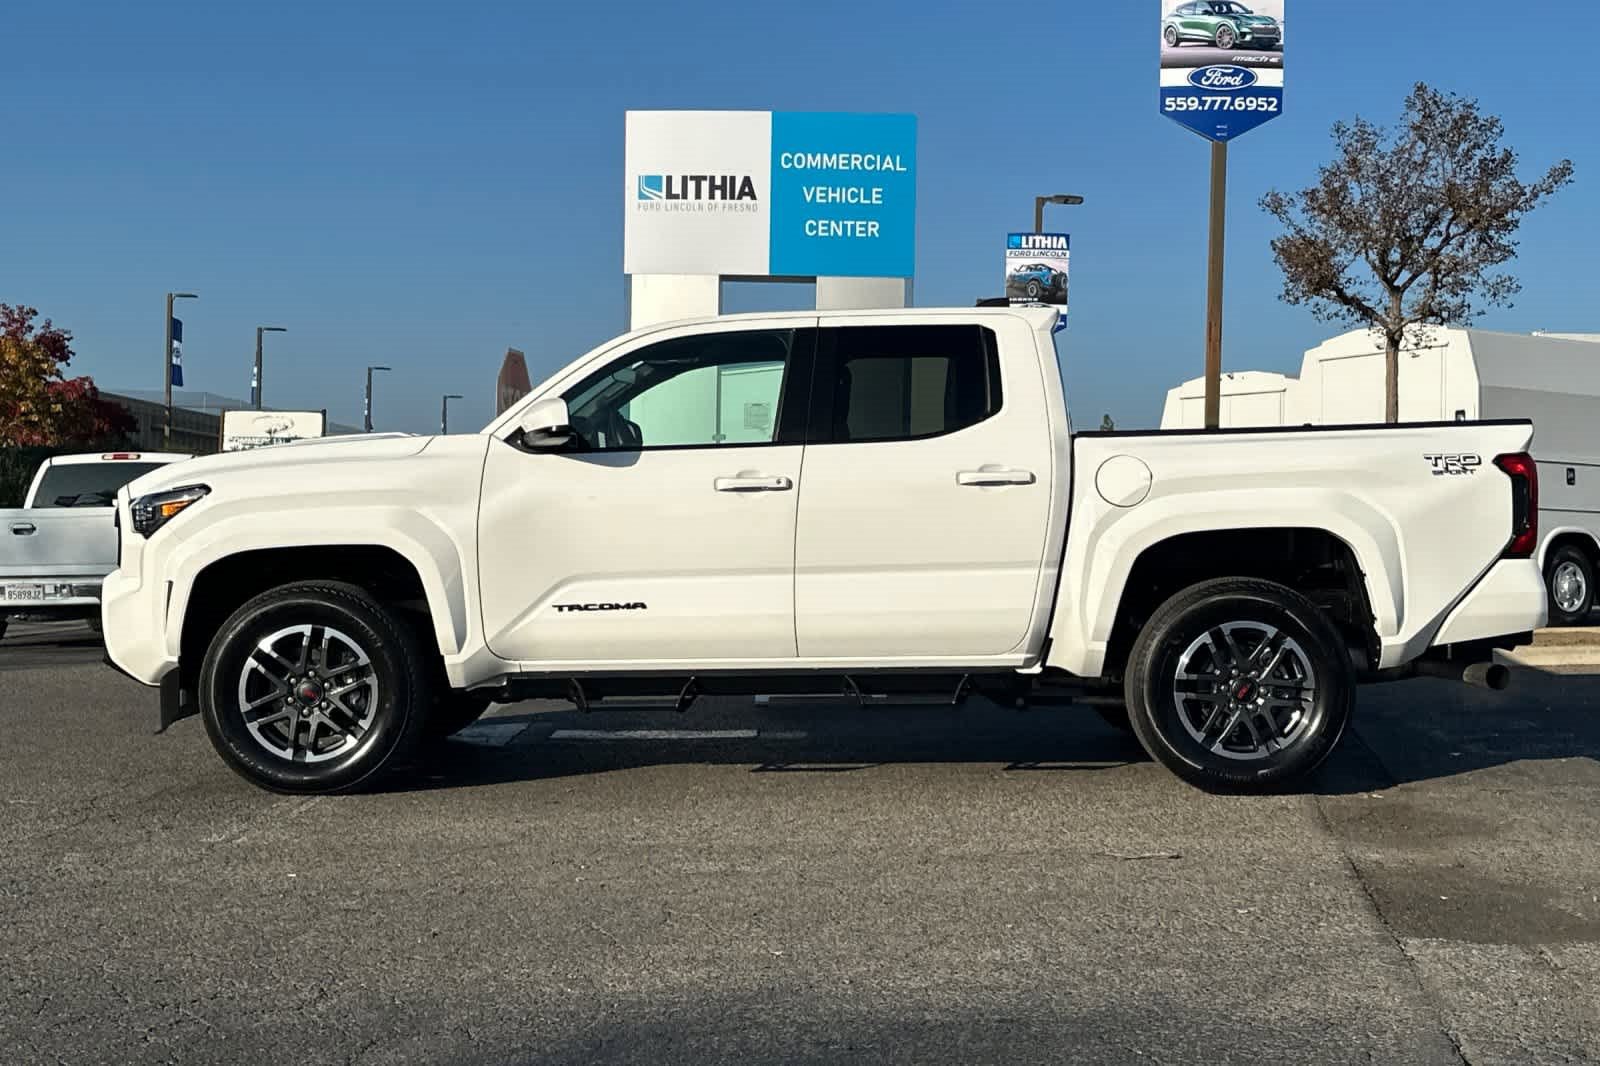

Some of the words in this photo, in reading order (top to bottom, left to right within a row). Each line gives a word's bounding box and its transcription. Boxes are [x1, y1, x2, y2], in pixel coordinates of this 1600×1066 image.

[1201, 67, 1244, 86] Ford
[1164, 96, 1278, 112] 559.777.6952
[780, 152, 907, 172] COMMERCIAL
[665, 175, 757, 200] LITHIA
[803, 186, 883, 205] VEHICLE
[637, 202, 661, 212] FORD
[664, 202, 704, 212] LINCOLN
[707, 203, 719, 212] OF
[722, 203, 758, 212] FRESNO
[804, 219, 880, 238] CENTER
[1021, 236, 1067, 249] LITHIA
[1424, 453, 1482, 470] TRD
[552, 602, 647, 612] TACOMA
